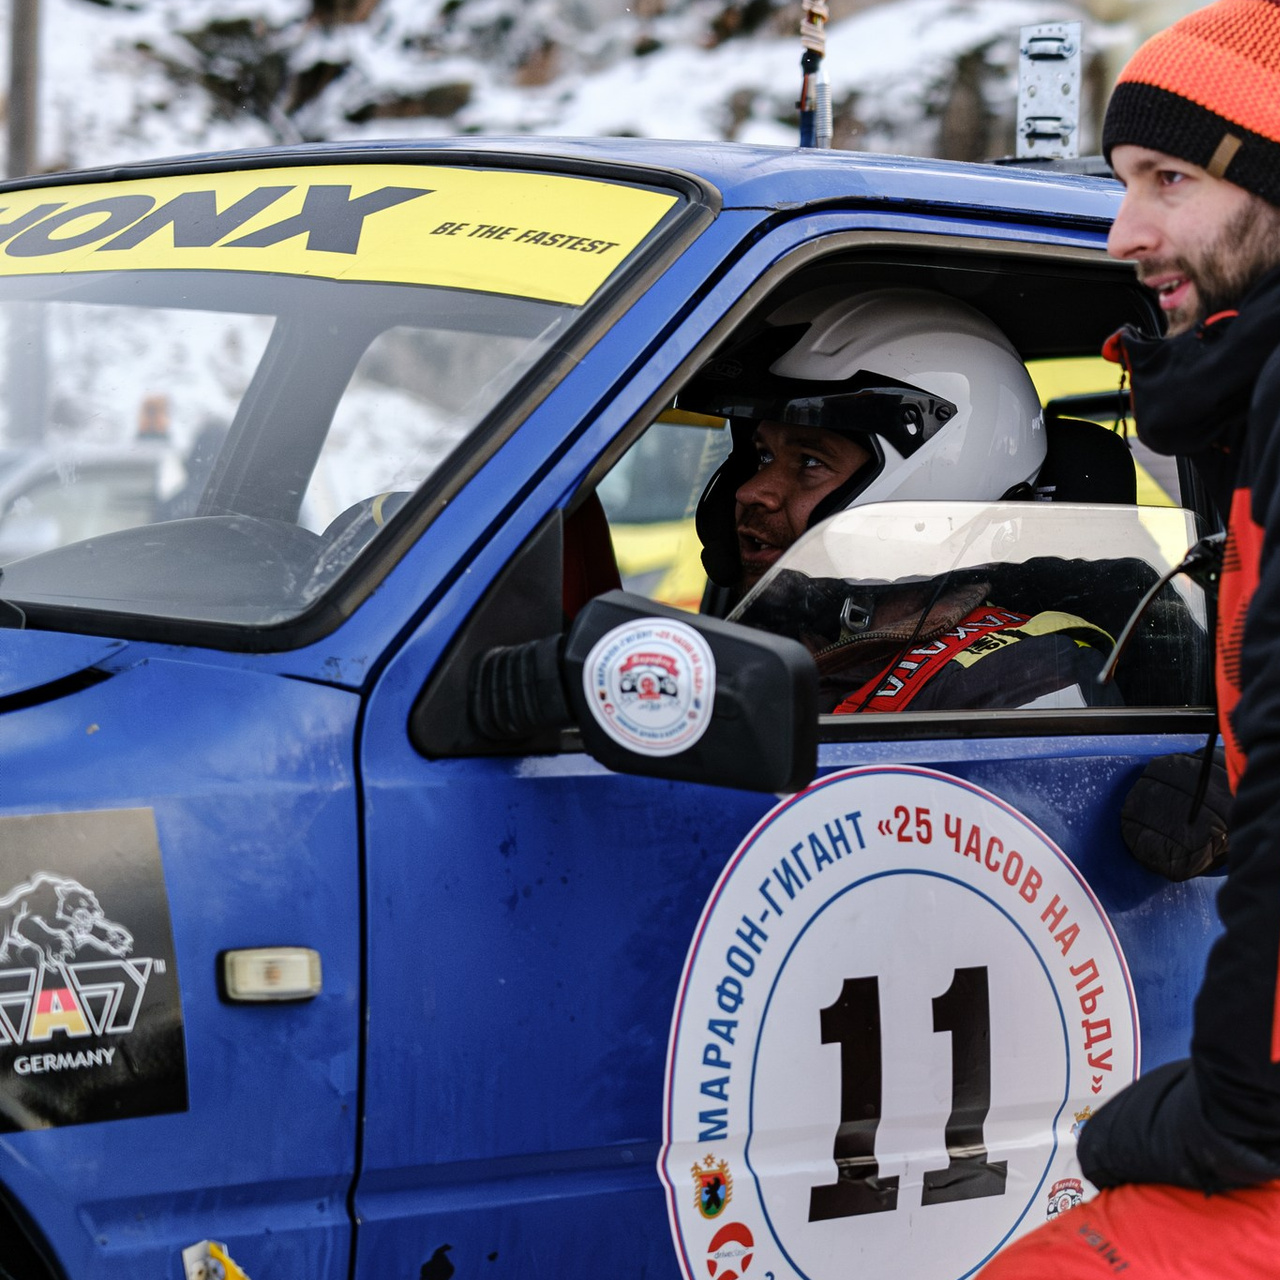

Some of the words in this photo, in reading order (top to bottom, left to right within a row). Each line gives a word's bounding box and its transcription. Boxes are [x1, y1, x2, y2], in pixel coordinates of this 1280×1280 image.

[429, 221, 470, 236] BE
[467, 223, 517, 240] THE
[513, 229, 620, 255] FASTEST
[873, 611, 1026, 697] TAKATA
[698, 811, 867, 1143] МАРАФОН-ГИГАНТ
[877, 805, 933, 844] «25
[944, 813, 1043, 904] ЧАСОВ
[1040, 894, 1082, 957] НА
[1069, 958, 1113, 1094] ЛЬДУ»
[14, 1046, 116, 1075] GERMANY
[808, 965, 1009, 1222] 11
